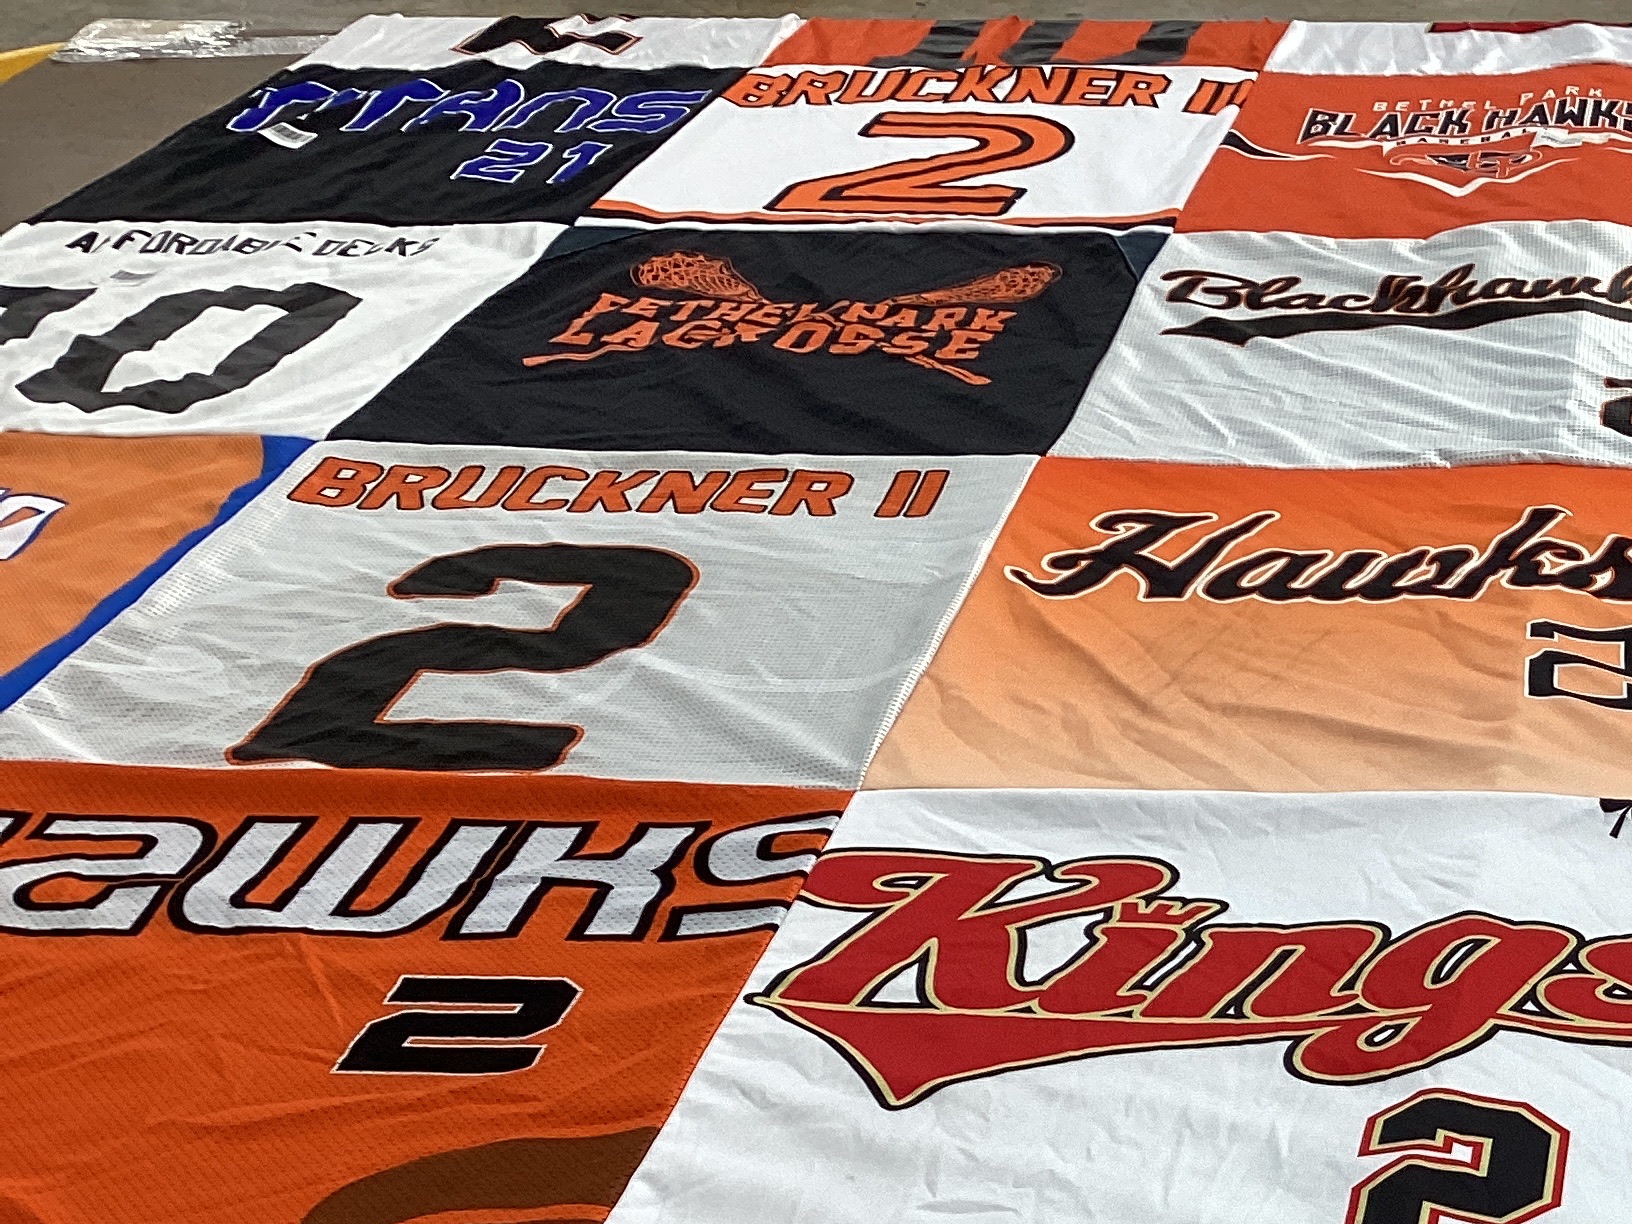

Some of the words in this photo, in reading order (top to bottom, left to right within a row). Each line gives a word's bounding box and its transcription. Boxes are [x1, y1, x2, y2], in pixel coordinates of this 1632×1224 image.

[719, 64, 1172, 110] BRUCKNER
[1373, 100, 1498, 112] BETHEL
[1519, 85, 1603, 106] PARK
[1297, 108, 1473, 145] BLACK
[449, 139, 612, 184] 21
[762, 111, 1075, 216] 2
[65, 229, 317, 255] AFORDABE
[287, 455, 853, 517] BRUCKNER
[872, 468, 950, 519] II
[224, 543, 700, 773] 2
[0, 808, 844, 943] AWKS
[330, 974, 585, 1076] 2
